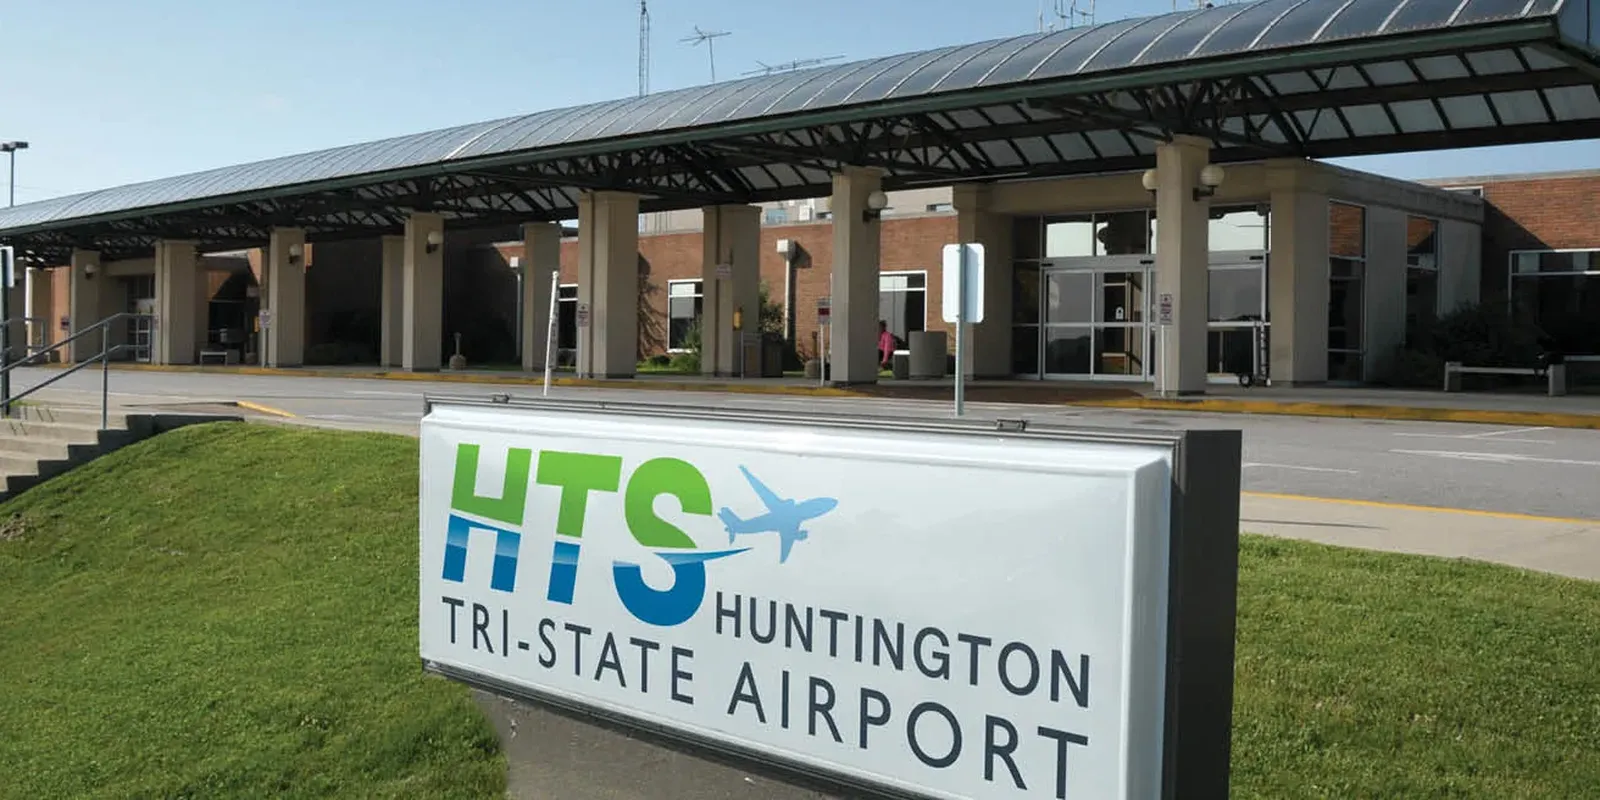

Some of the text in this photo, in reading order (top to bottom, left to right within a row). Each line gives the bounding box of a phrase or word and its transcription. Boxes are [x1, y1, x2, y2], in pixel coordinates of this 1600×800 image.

[442, 443, 716, 627] HTS
[441, 595, 1090, 800] TRI-STATE AIRPORT
[715, 591, 1091, 709] HUNTINGTON
